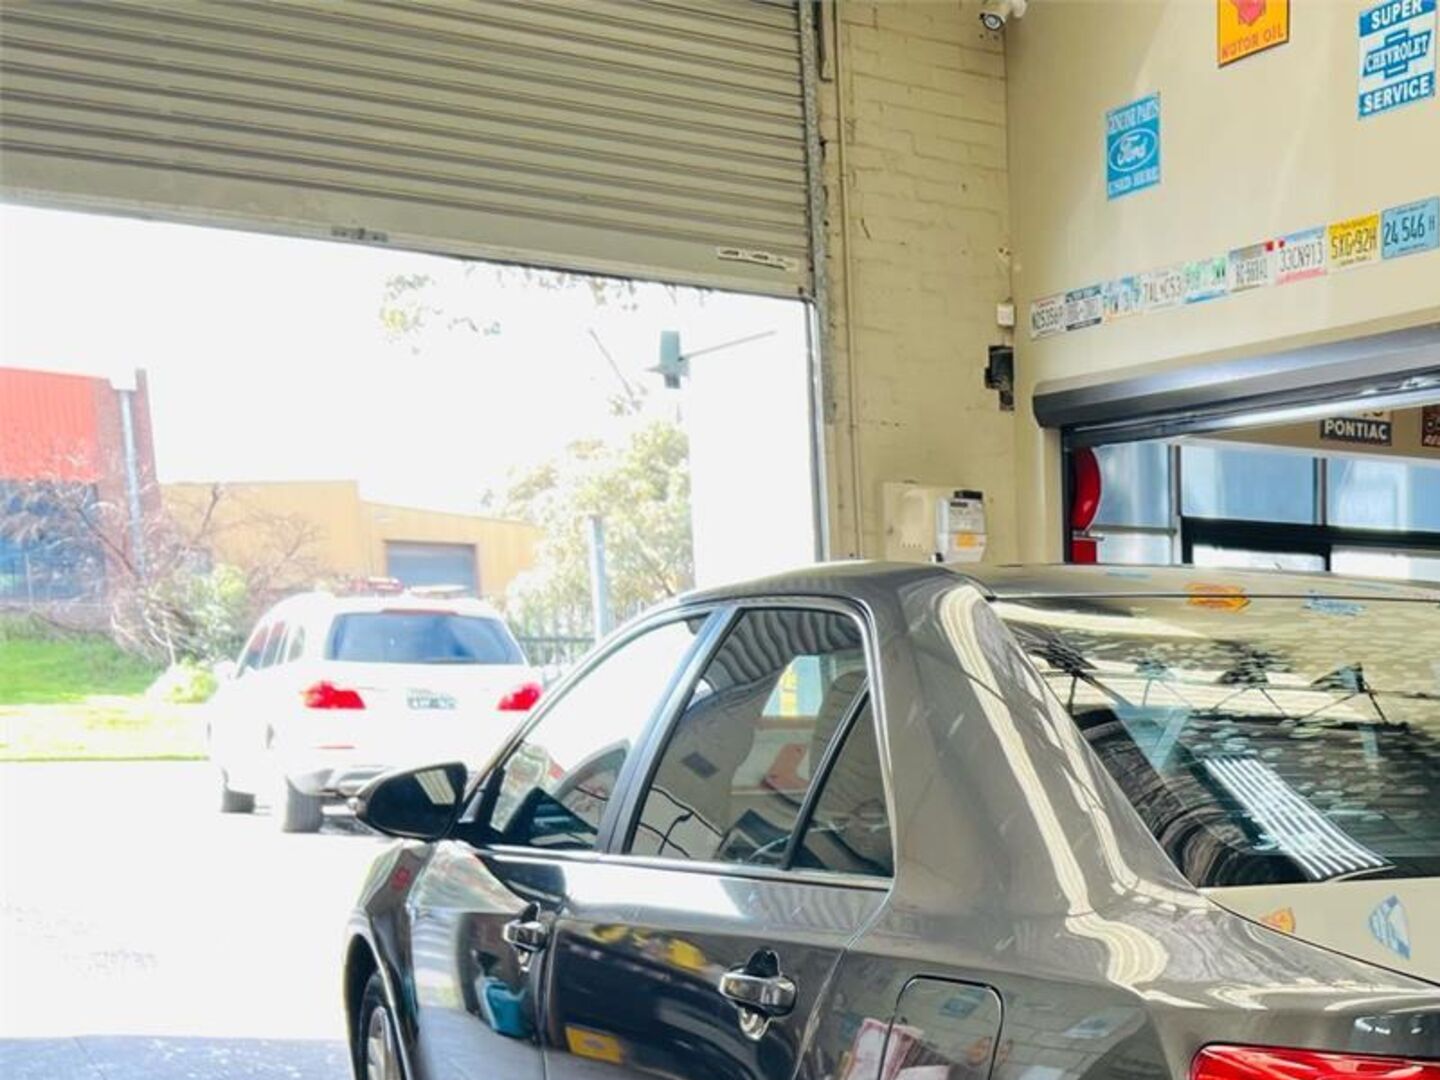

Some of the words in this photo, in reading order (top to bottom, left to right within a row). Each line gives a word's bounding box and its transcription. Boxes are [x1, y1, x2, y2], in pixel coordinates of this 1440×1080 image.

[1371, 0, 1423, 29] SUPER
[1221, 32, 1259, 59] MOTOR
[1263, 23, 1285, 42] OIL
[1366, 34, 1429, 72] CHEVROLET
[1363, 76, 1430, 113] SERVICE
[1117, 134, 1148, 166] Ford
[1323, 419, 1388, 440] PONTIAC
